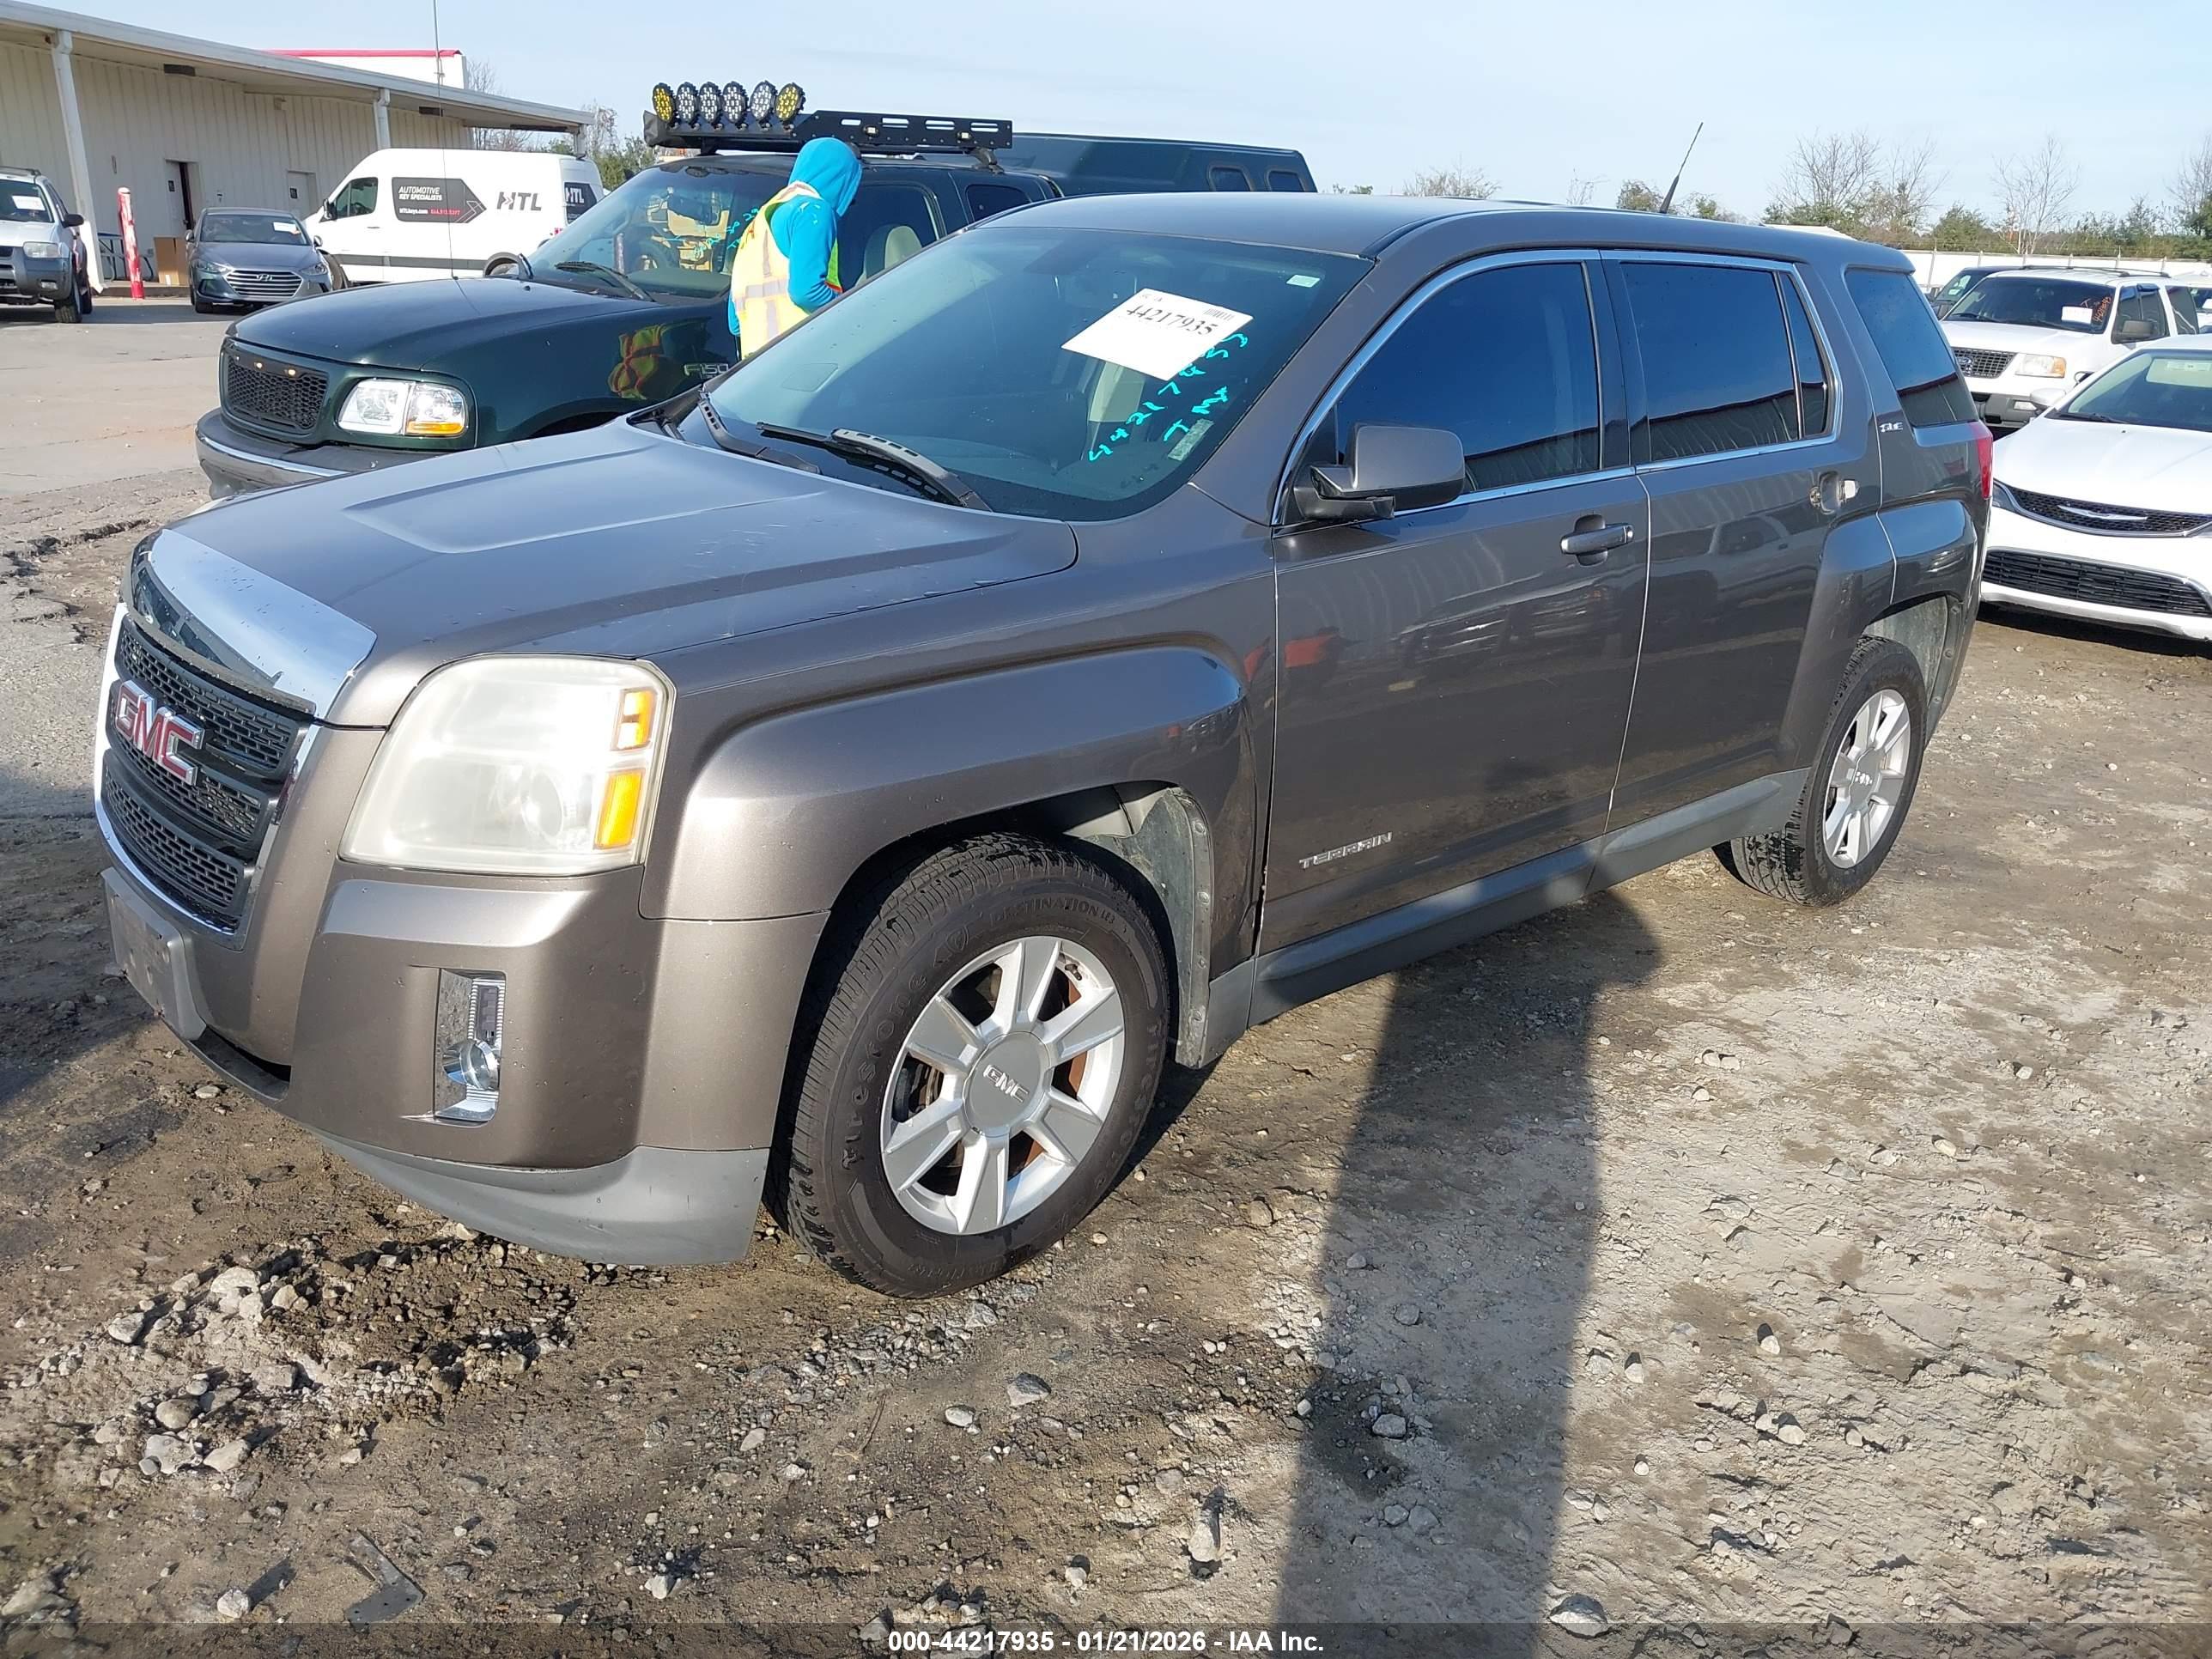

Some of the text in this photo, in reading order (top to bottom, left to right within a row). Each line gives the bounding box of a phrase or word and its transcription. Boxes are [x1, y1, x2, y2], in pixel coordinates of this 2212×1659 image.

[398, 186, 440, 195] AUTOMOTIVE
[496, 191, 542, 211] HTL
[1126, 305, 1219, 336] 44217935
[115, 679, 206, 787] GMC
[1298, 831, 1393, 869] TERRAIN
[983, 1064, 1030, 1103] GMC
